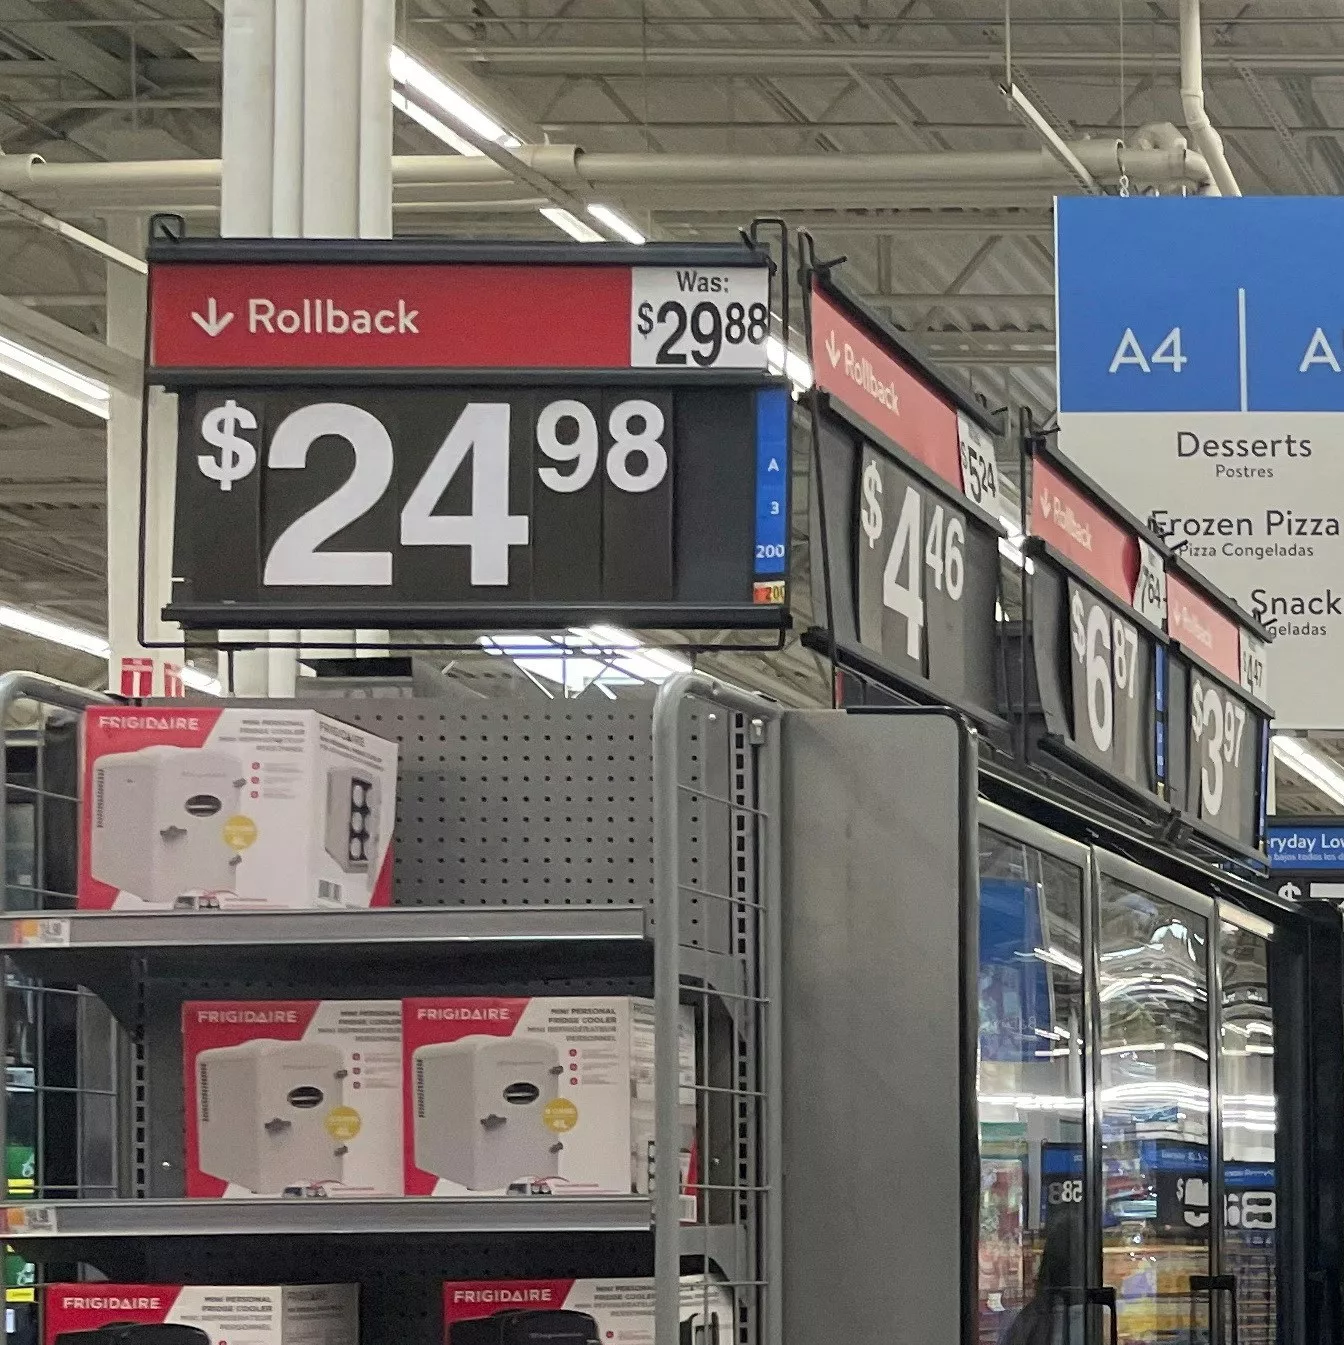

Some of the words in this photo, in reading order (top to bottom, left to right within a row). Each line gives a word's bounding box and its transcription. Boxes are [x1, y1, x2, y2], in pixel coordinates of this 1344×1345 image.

[676, 270, 730, 294] Was:
[248, 299, 420, 335] Rollback
[1109, 327, 1188, 373] A4
[844, 344, 899, 415] Rollback
[1177, 431, 1312, 458] Desserts
[767, 457, 780, 472] A
[1215, 464, 1274, 478] Postres
[770, 501, 780, 515] 3
[1152, 510, 1253, 536] Frozen
[1266, 510, 1340, 536] Pizza
[756, 544, 785, 558] 200
[1178, 543, 1217, 557] Pizza
[1222, 543, 1314, 560] Congeladas
[1268, 622, 1327, 639] geladas
[99, 716, 200, 732] FRIGIDAIRE
[1269, 834, 1316, 853] ryday
[197, 1010, 298, 1023] FRIGIDAIRE
[417, 1008, 511, 1021] FRIGIDAIRE
[63, 1297, 162, 1310] FRIGIDAIRE
[454, 1288, 552, 1303] FRIGIDAIRE
